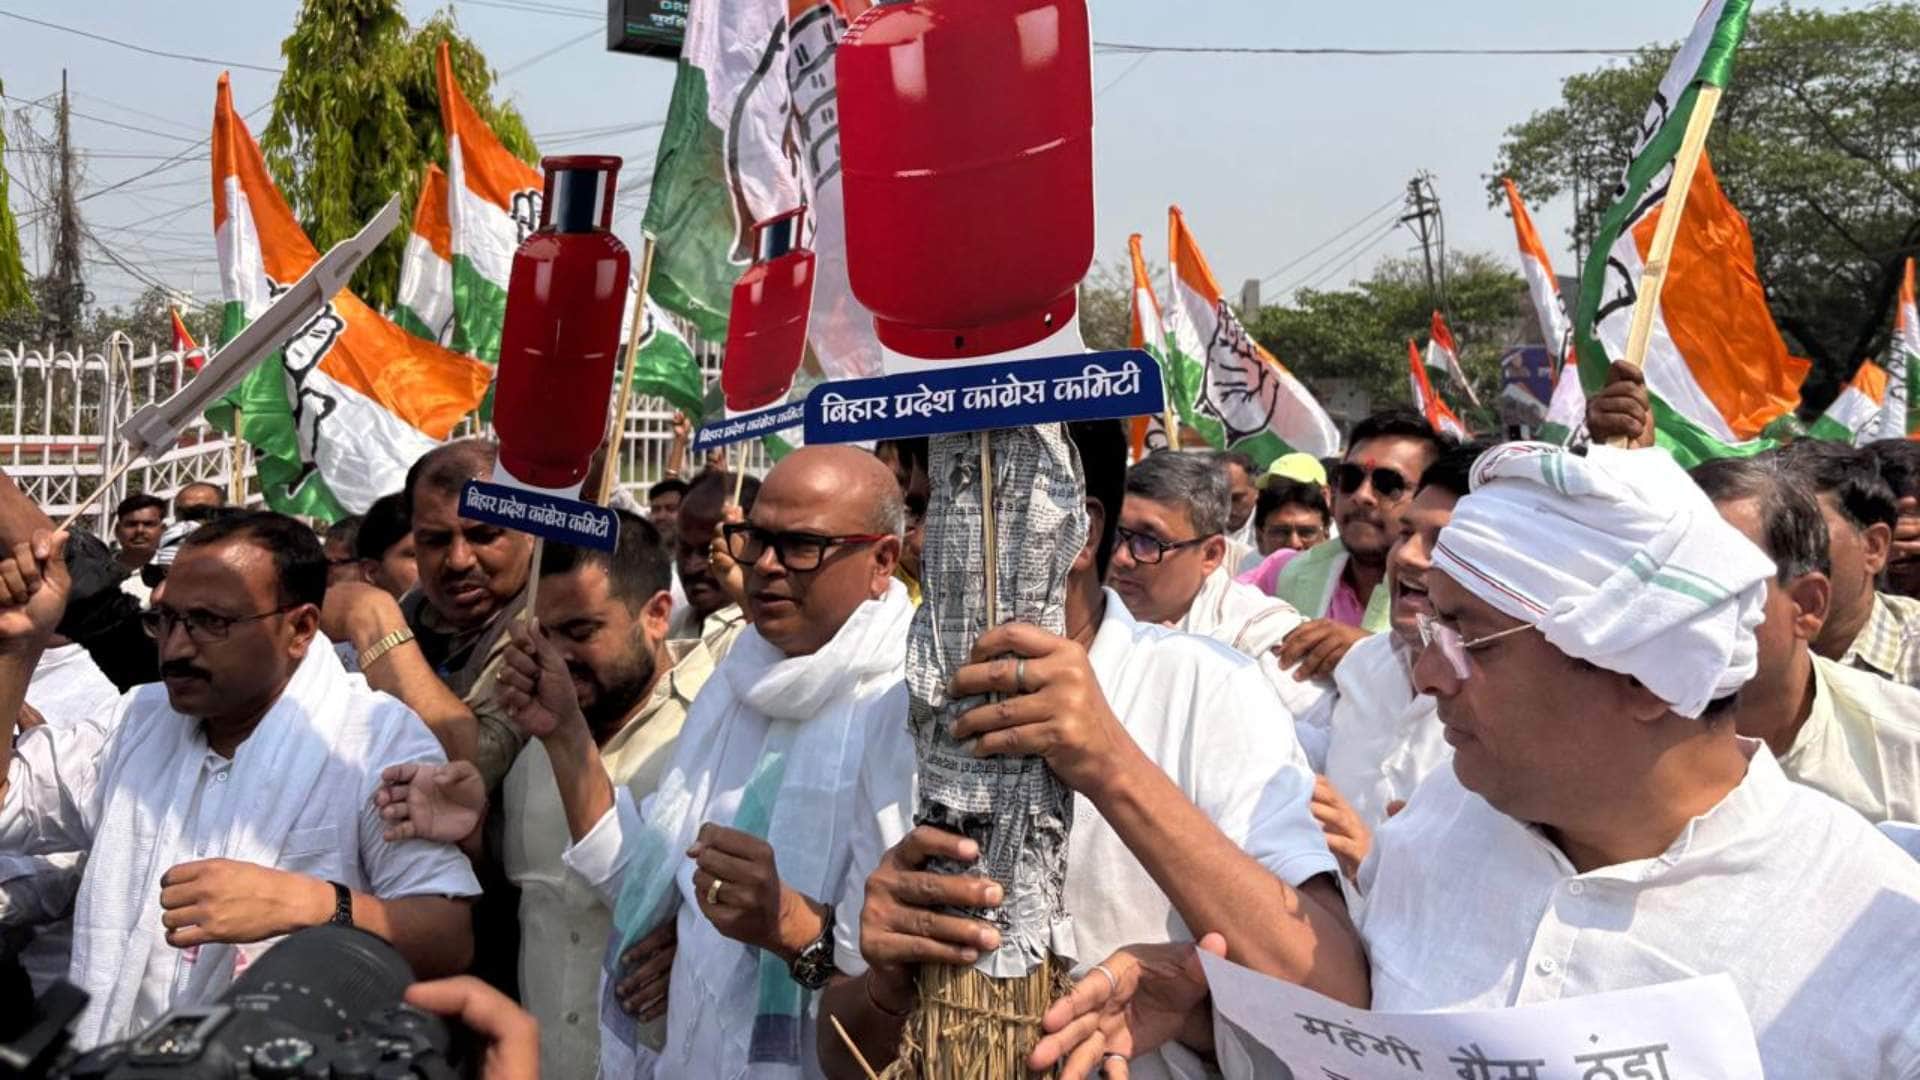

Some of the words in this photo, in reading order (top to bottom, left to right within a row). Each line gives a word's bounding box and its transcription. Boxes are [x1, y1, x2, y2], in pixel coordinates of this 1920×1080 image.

[821, 392, 888, 424] बिहार
[894, 384, 956, 418] प्रदेश
[962, 374, 1046, 410] कांग्रेस
[1053, 361, 1142, 402] कमिटी
[466, 486, 497, 511] बिहार
[498, 495, 527, 519] प्रदेश
[528, 504, 567, 528] कांग्रेस
[569, 511, 610, 537] कमिटी
[1293, 1012, 1422, 1072] महंगी
